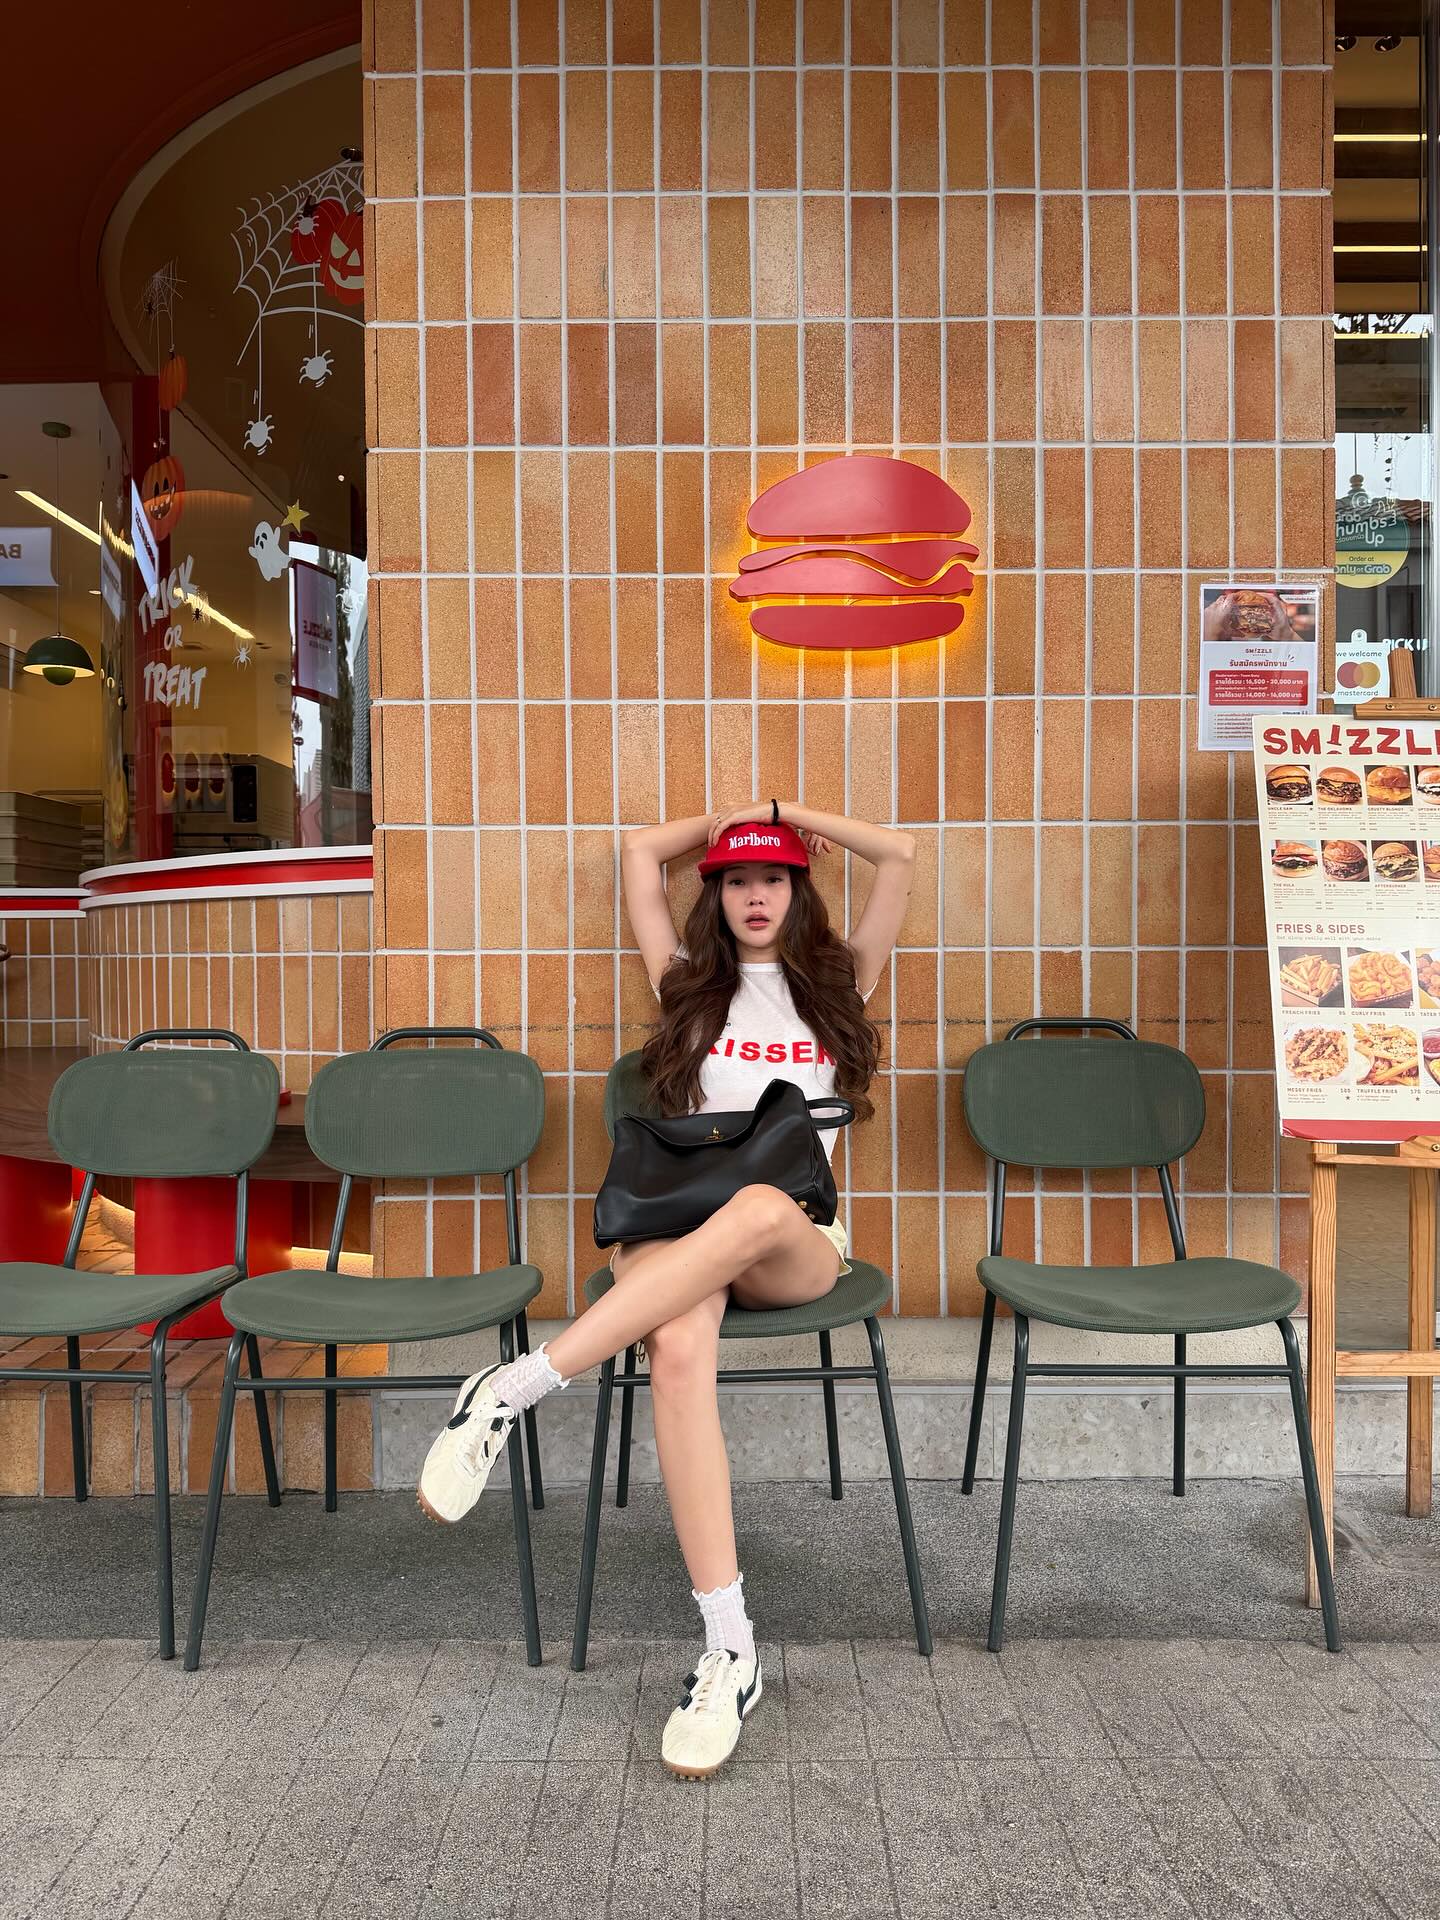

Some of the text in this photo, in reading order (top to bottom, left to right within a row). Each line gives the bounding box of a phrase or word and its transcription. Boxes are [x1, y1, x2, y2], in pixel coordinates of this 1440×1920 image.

[139, 554, 200, 635] TRICK
[164, 624, 183, 650] OR
[143, 660, 207, 710] TREAT
[728, 832, 780, 851] Marlboro
[1276, 924, 1365, 934] FRIES & SIDES
